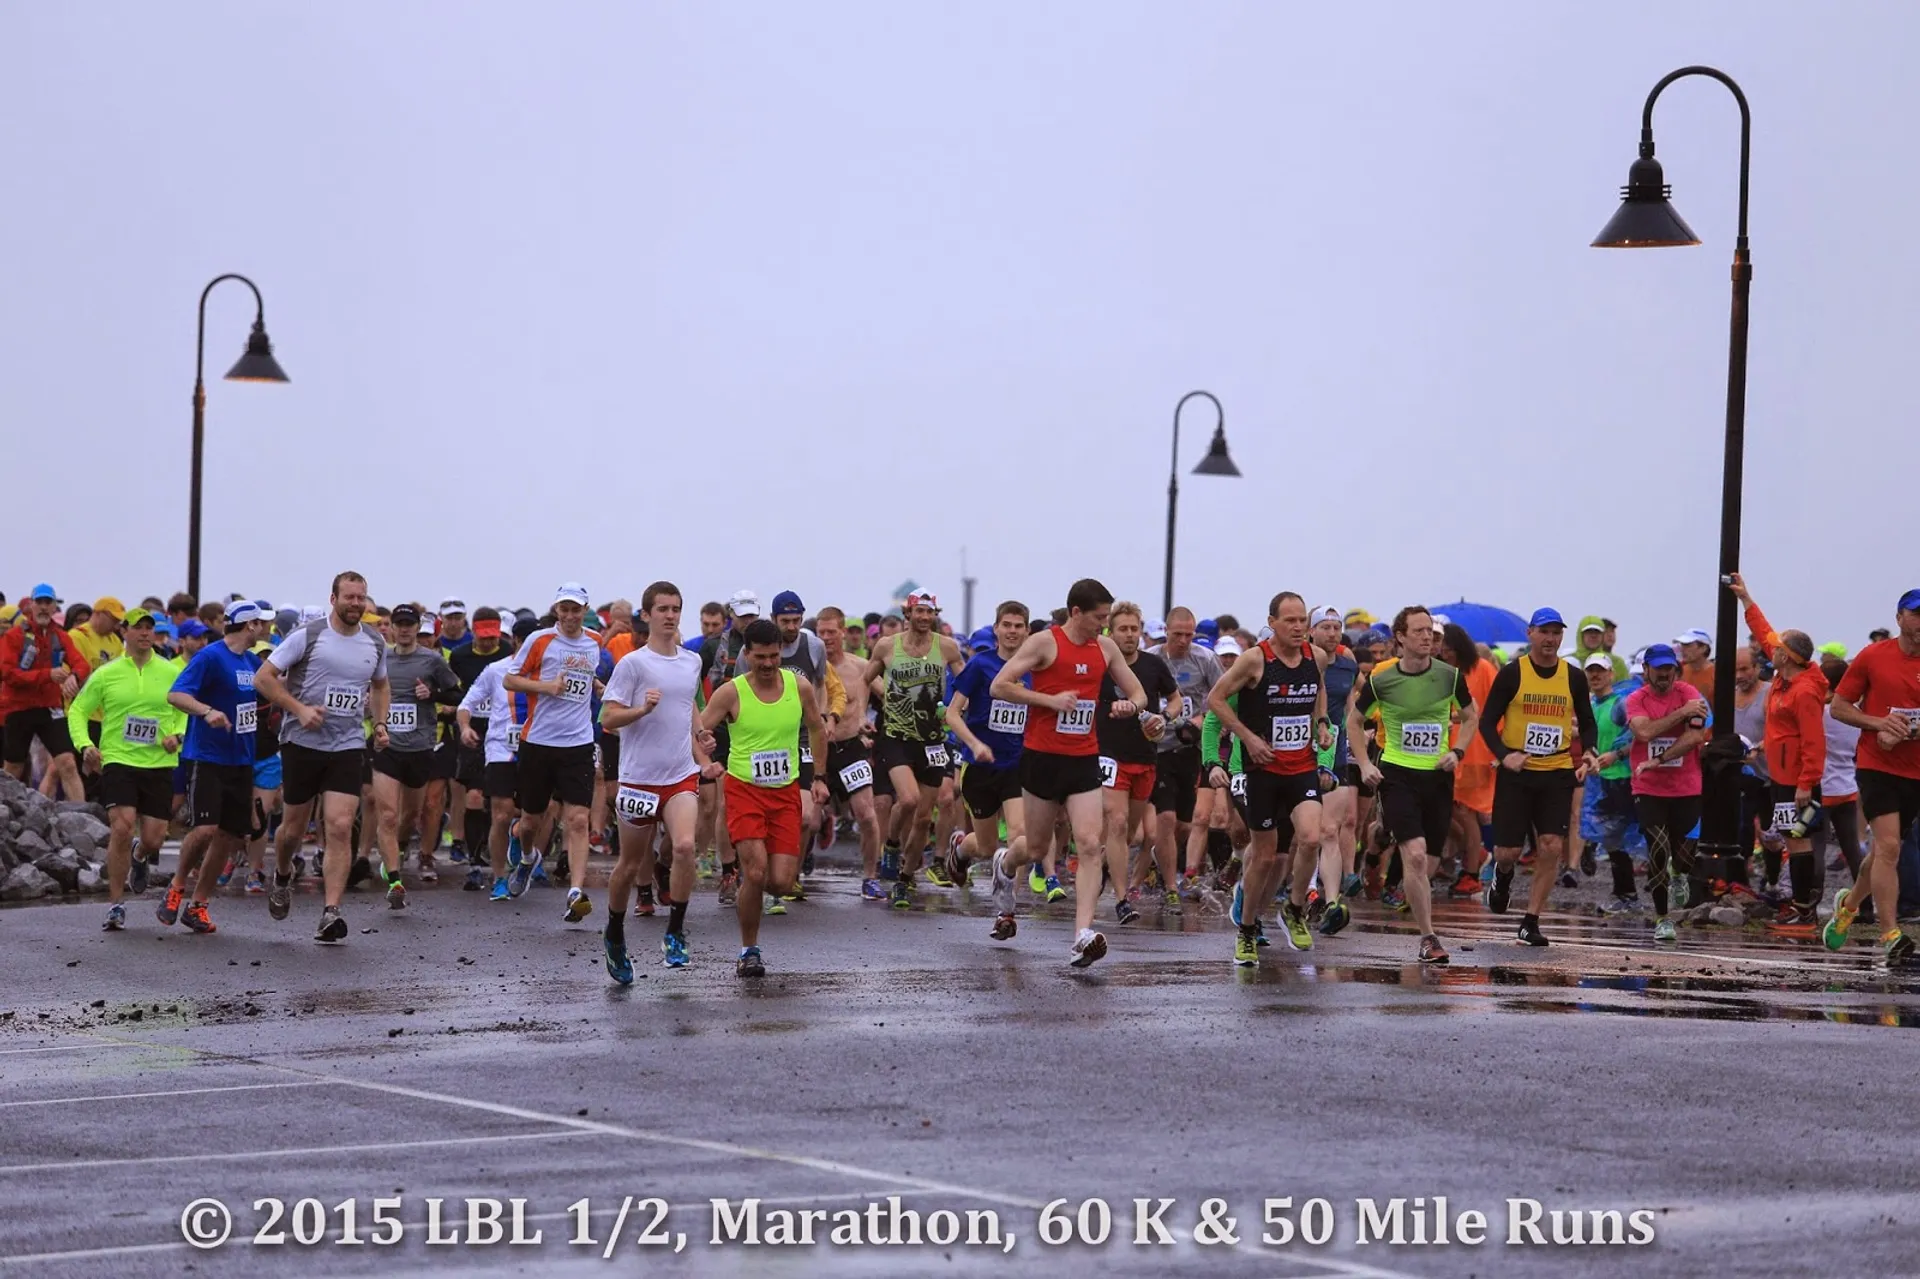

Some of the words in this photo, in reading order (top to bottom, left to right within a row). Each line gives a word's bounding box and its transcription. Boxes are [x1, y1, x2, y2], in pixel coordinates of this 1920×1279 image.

[1075, 663, 1088, 675] M
[565, 678, 587, 696] 952
[1267, 683, 1318, 697] POLAR
[328, 692, 359, 710] 1972
[385, 711, 415, 725] 2615
[993, 709, 1025, 726] 1810
[1060, 709, 1093, 726] 1910
[126, 723, 157, 739] 1979
[1274, 724, 1309, 743] 2632
[1403, 731, 1439, 748] 2625
[1527, 731, 1559, 749] 2624
[754, 758, 789, 778] 1814
[844, 765, 872, 786] 1803
[619, 796, 655, 816] 1982
